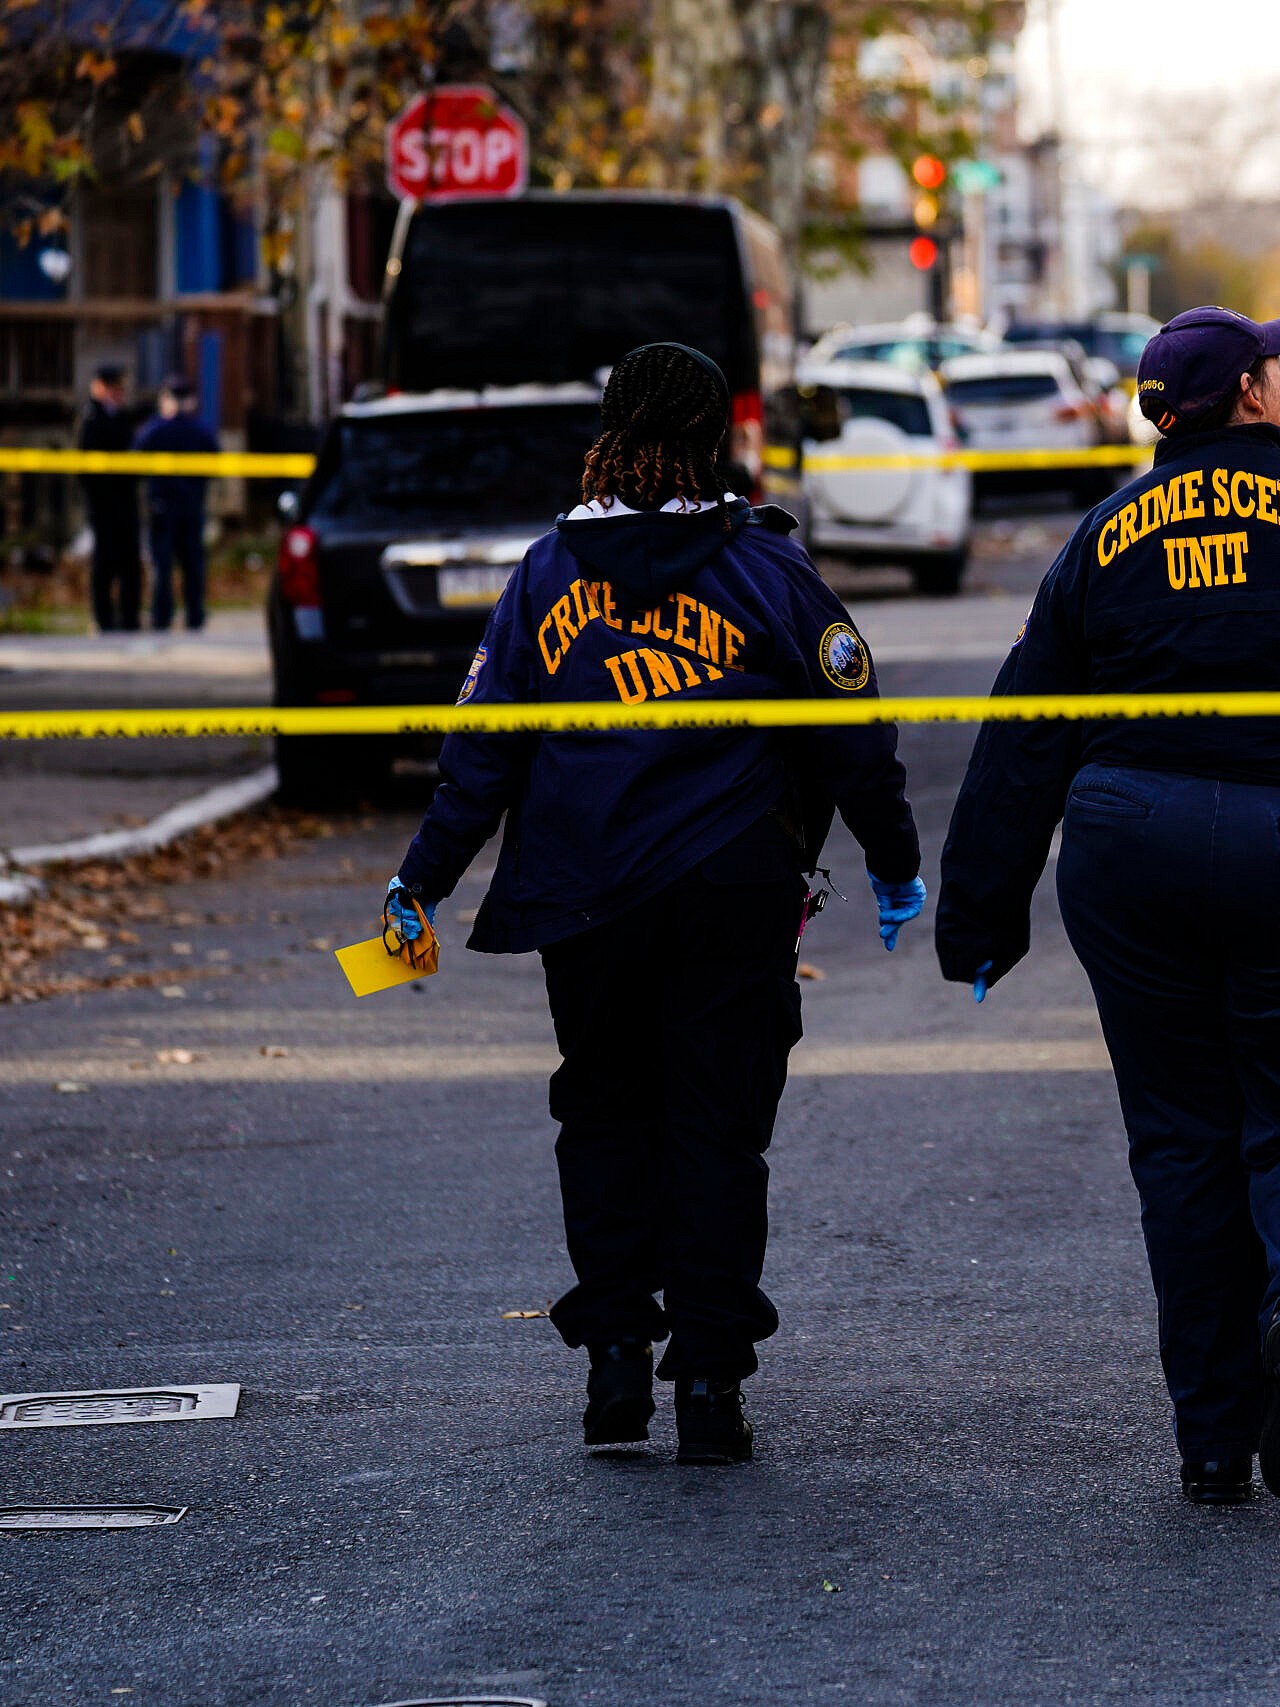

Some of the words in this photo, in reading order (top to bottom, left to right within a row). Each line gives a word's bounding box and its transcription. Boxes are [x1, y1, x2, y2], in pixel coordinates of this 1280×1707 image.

[400, 128, 513, 183] STOP
[1097, 469, 1206, 568] CRIME
[1163, 531, 1249, 591] UNIT
